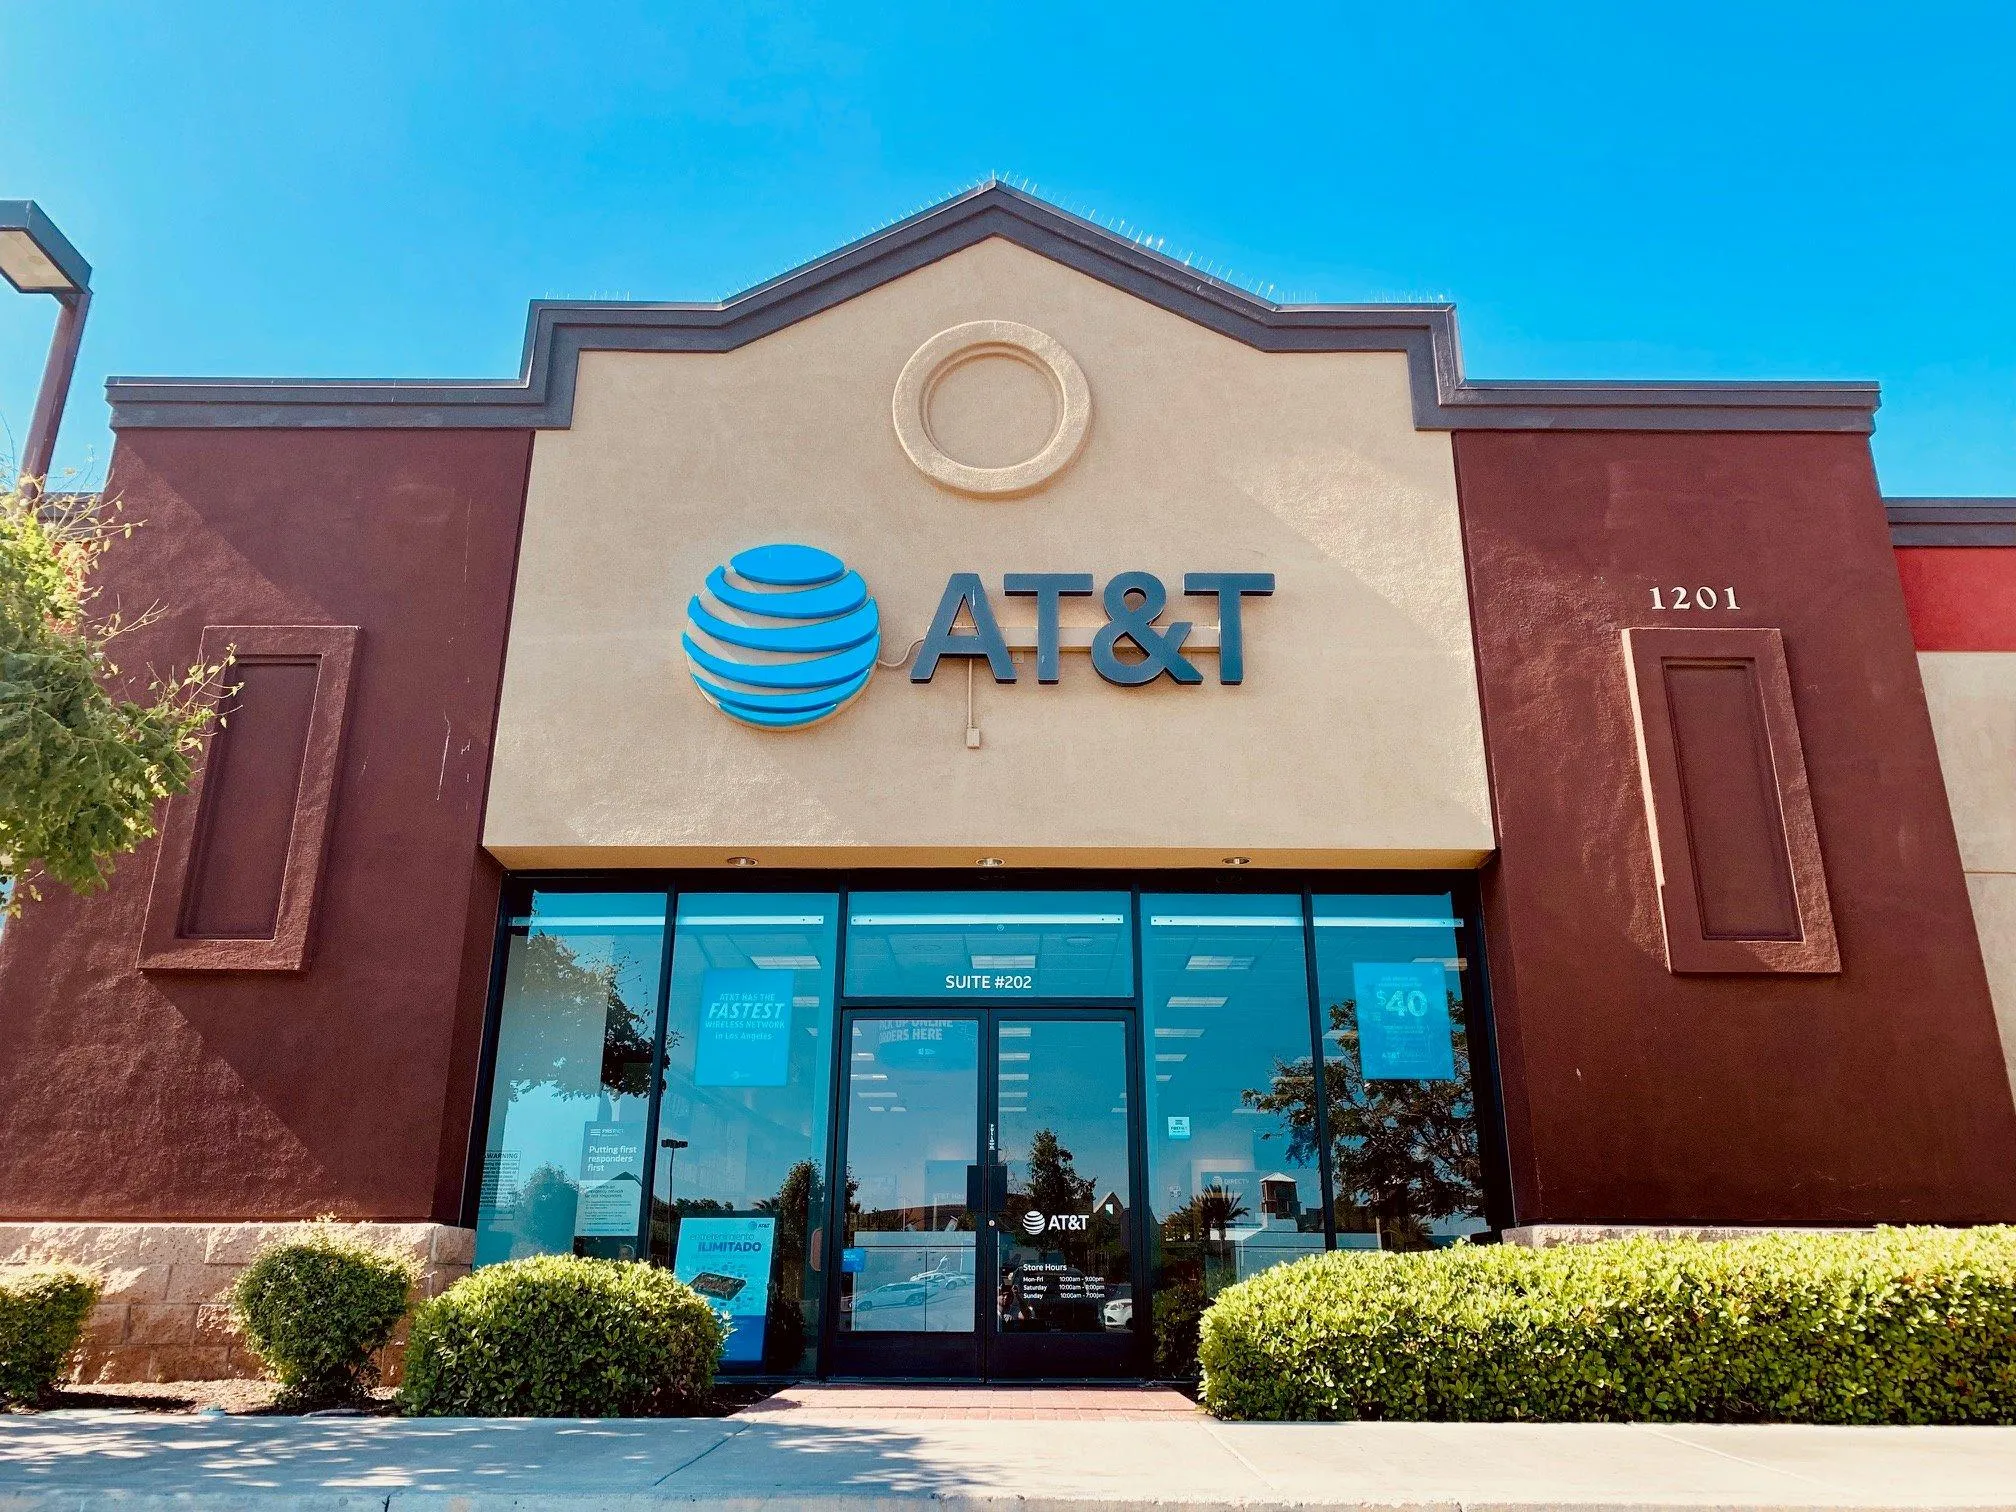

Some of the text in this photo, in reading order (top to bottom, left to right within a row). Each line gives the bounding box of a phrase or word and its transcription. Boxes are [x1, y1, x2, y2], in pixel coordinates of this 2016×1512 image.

[1649, 586, 1741, 610] 1201
[909, 571, 1276, 687] AT&T
[945, 975, 1032, 989] SUITE #202
[742, 993, 758, 1001] HAS
[759, 993, 776, 1001] THE
[1376, 989, 1428, 1017] $40
[708, 1002, 786, 1019] FASTEST
[705, 1020, 785, 1029] WIRELESS NETWORK
[725, 1032, 738, 1040] Los
[912, 1028, 943, 1041] HERE
[589, 1145, 637, 1155] Putting first
[588, 1155, 633, 1164] responders
[587, 1163, 605, 1172] first
[1048, 1214, 1090, 1231] AT&T
[697, 1241, 762, 1252] ILIMITADO
[1023, 1263, 1068, 1272] Store Hours
[1023, 1284, 1047, 1292] Saturday
[1023, 1292, 1043, 1300] Sunday
